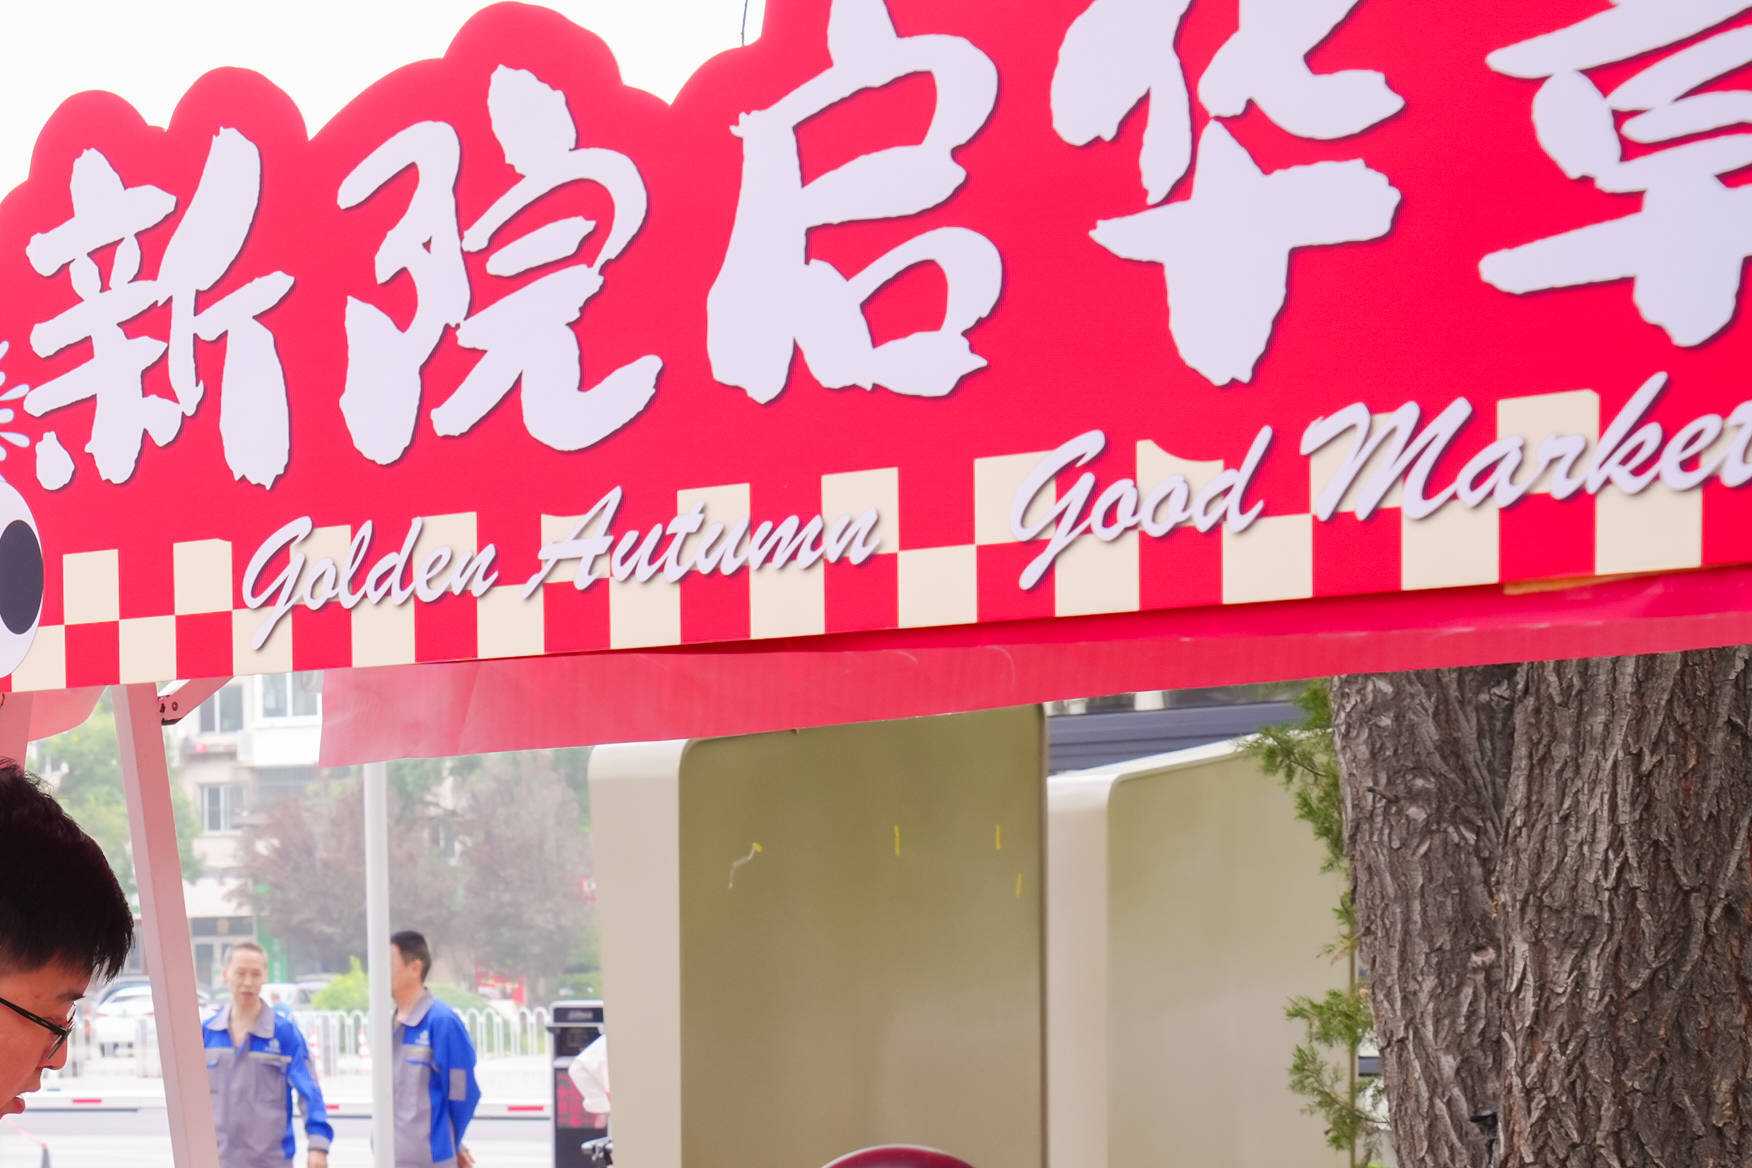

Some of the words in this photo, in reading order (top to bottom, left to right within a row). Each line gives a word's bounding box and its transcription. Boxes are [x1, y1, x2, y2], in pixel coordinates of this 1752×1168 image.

[242, 517, 500, 651] Golden
[523, 486, 882, 601] Autumn
[1008, 428, 1273, 590] Good
